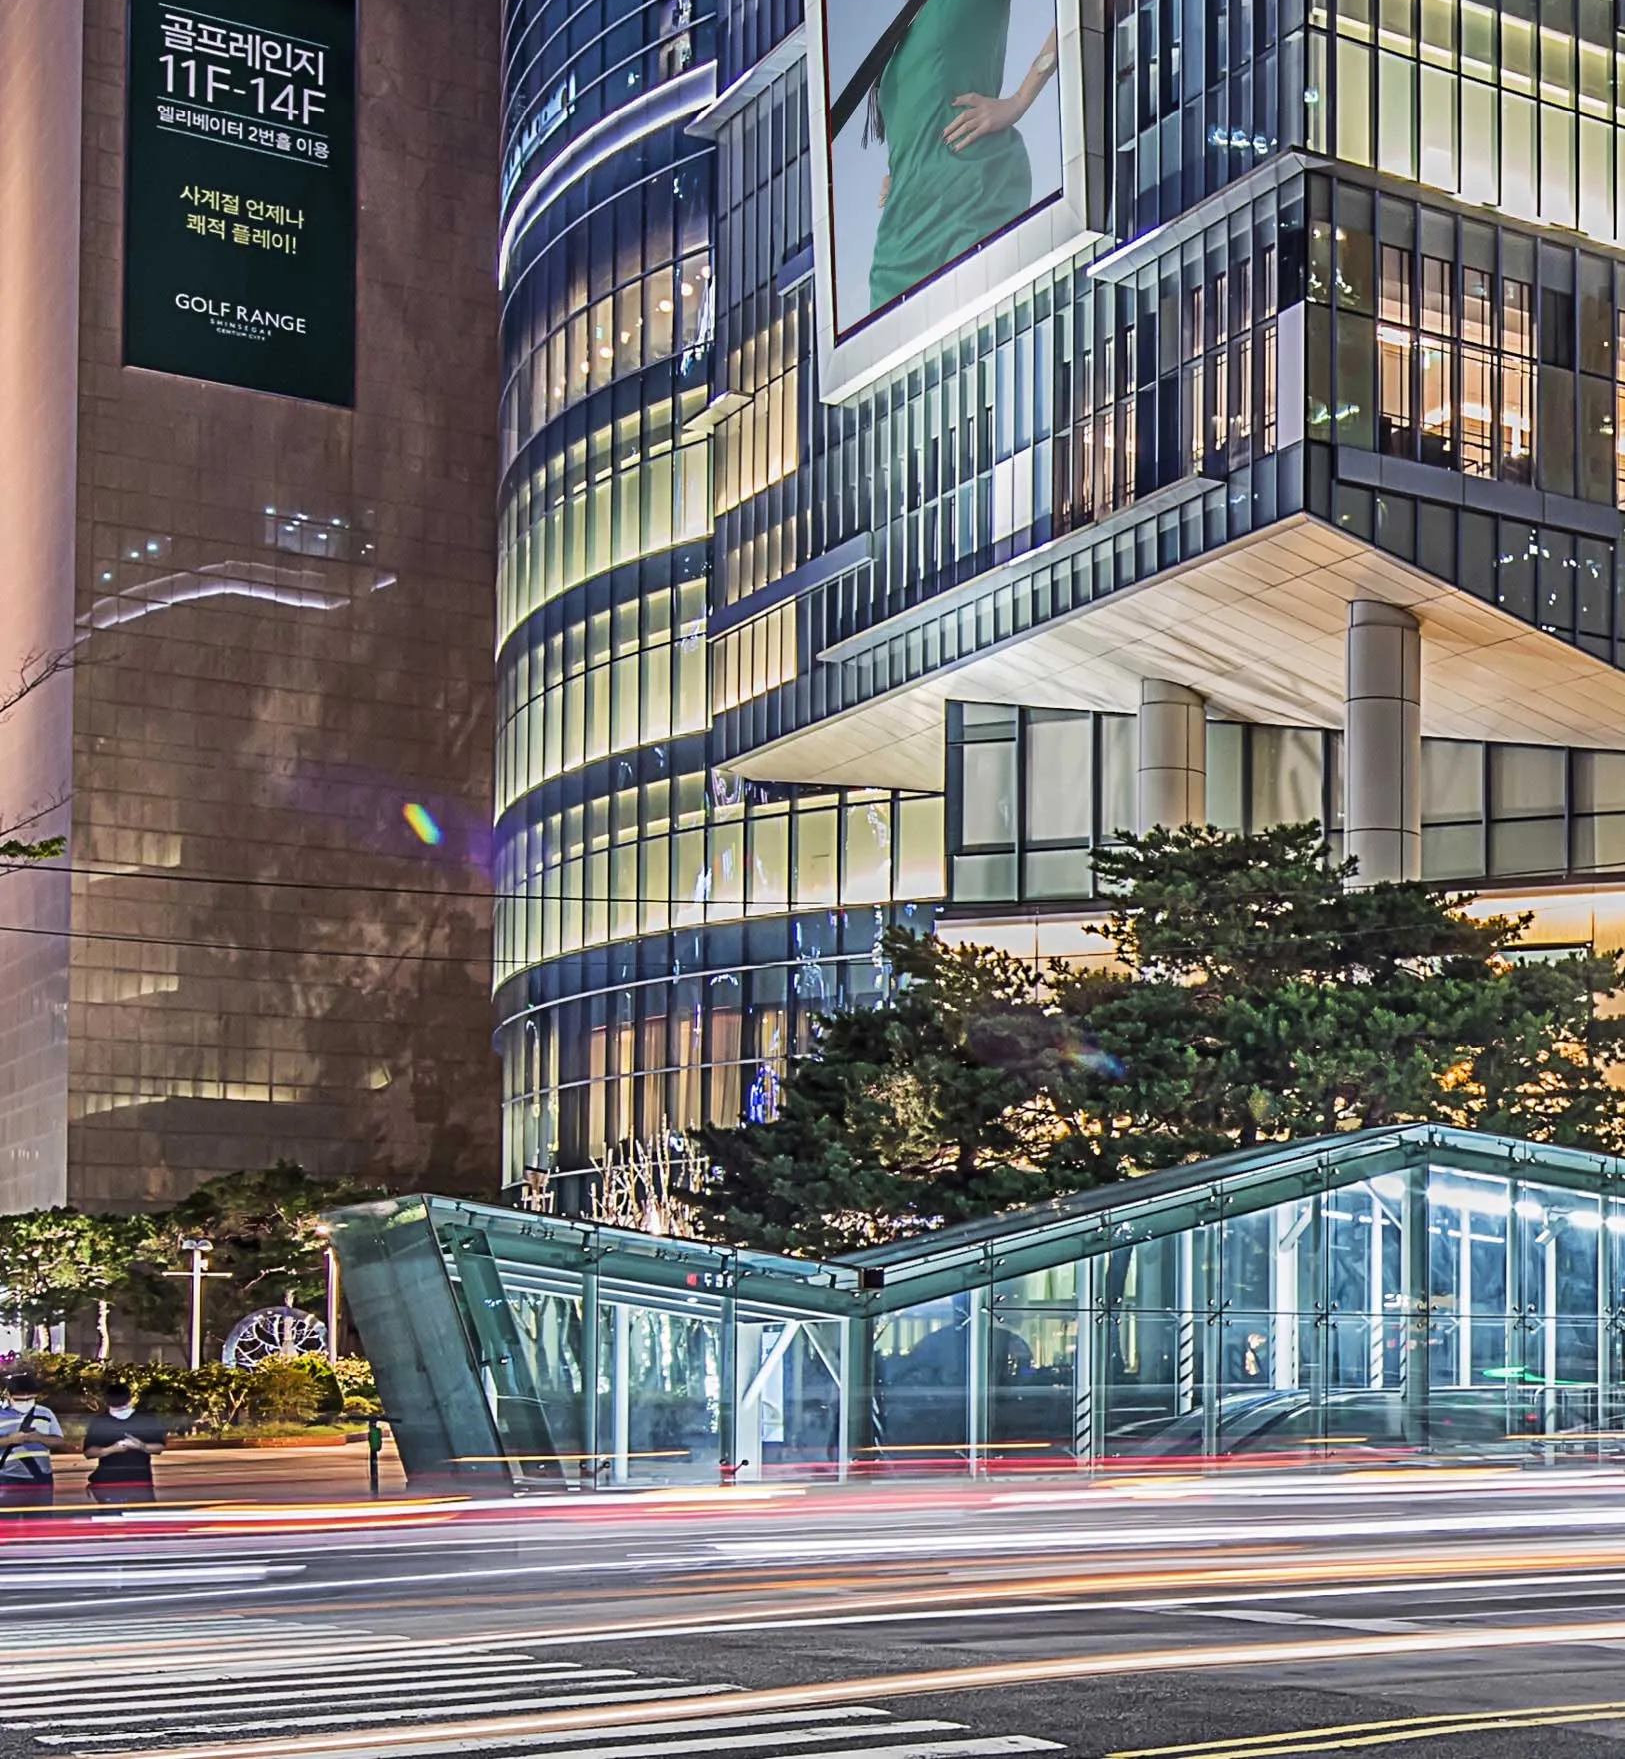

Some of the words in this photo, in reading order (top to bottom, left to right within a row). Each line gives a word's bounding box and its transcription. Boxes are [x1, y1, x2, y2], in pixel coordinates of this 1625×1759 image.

[161, 14, 324, 86] 골프레인지
[159, 54, 327, 125] 11F-14F
[157, 105, 243, 139] 엘리베이터
[296, 138, 330, 159] 이용
[180, 186, 240, 216] 사계절
[246, 200, 304, 229] 언제나
[187, 214, 227, 240] 쾌적
[232, 223, 297, 255] 플레이!
[175, 293, 231, 317] GOLF
[236, 305, 306, 334] RANGE
[210, 318, 272, 336] SHINSEGAE
